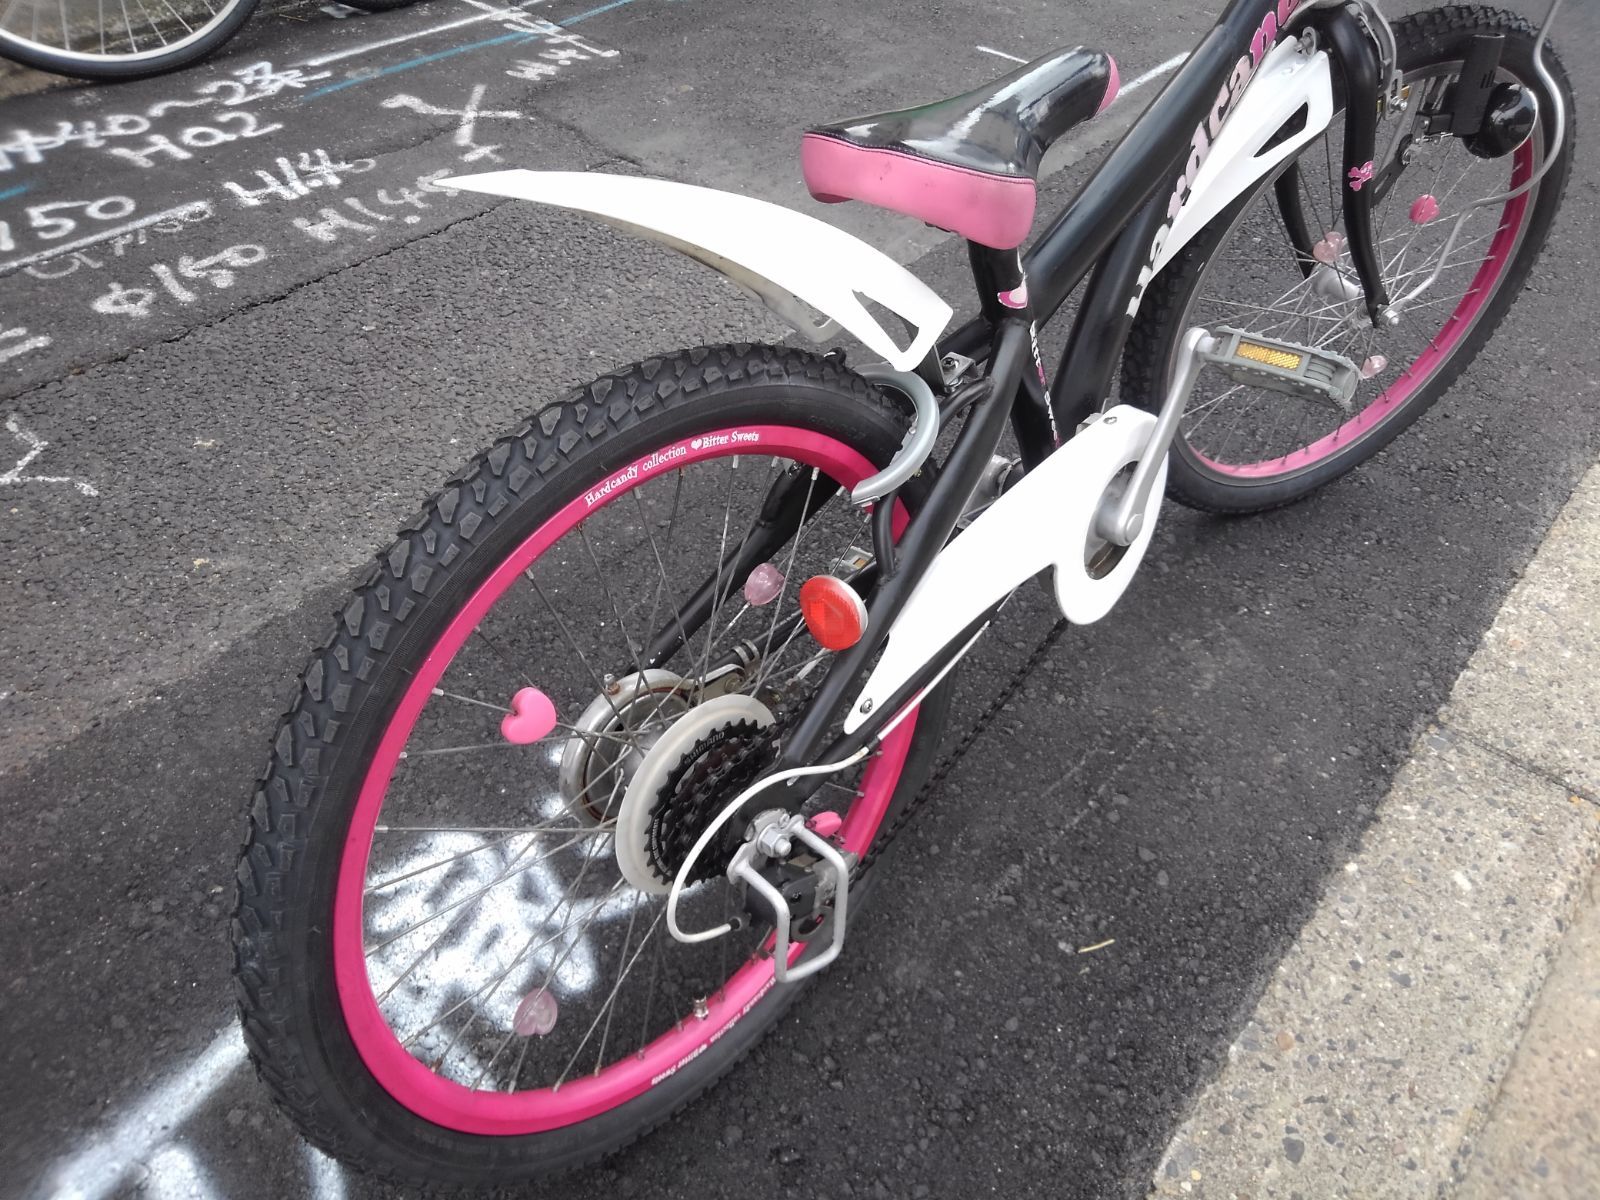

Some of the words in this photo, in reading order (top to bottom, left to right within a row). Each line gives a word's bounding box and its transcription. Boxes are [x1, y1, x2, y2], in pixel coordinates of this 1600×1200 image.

[584, 465, 639, 507] Hardcandy
[642, 446, 687, 472] collection
[702, 435, 730, 448] Bitter
[731, 430, 760, 443] Sweets
